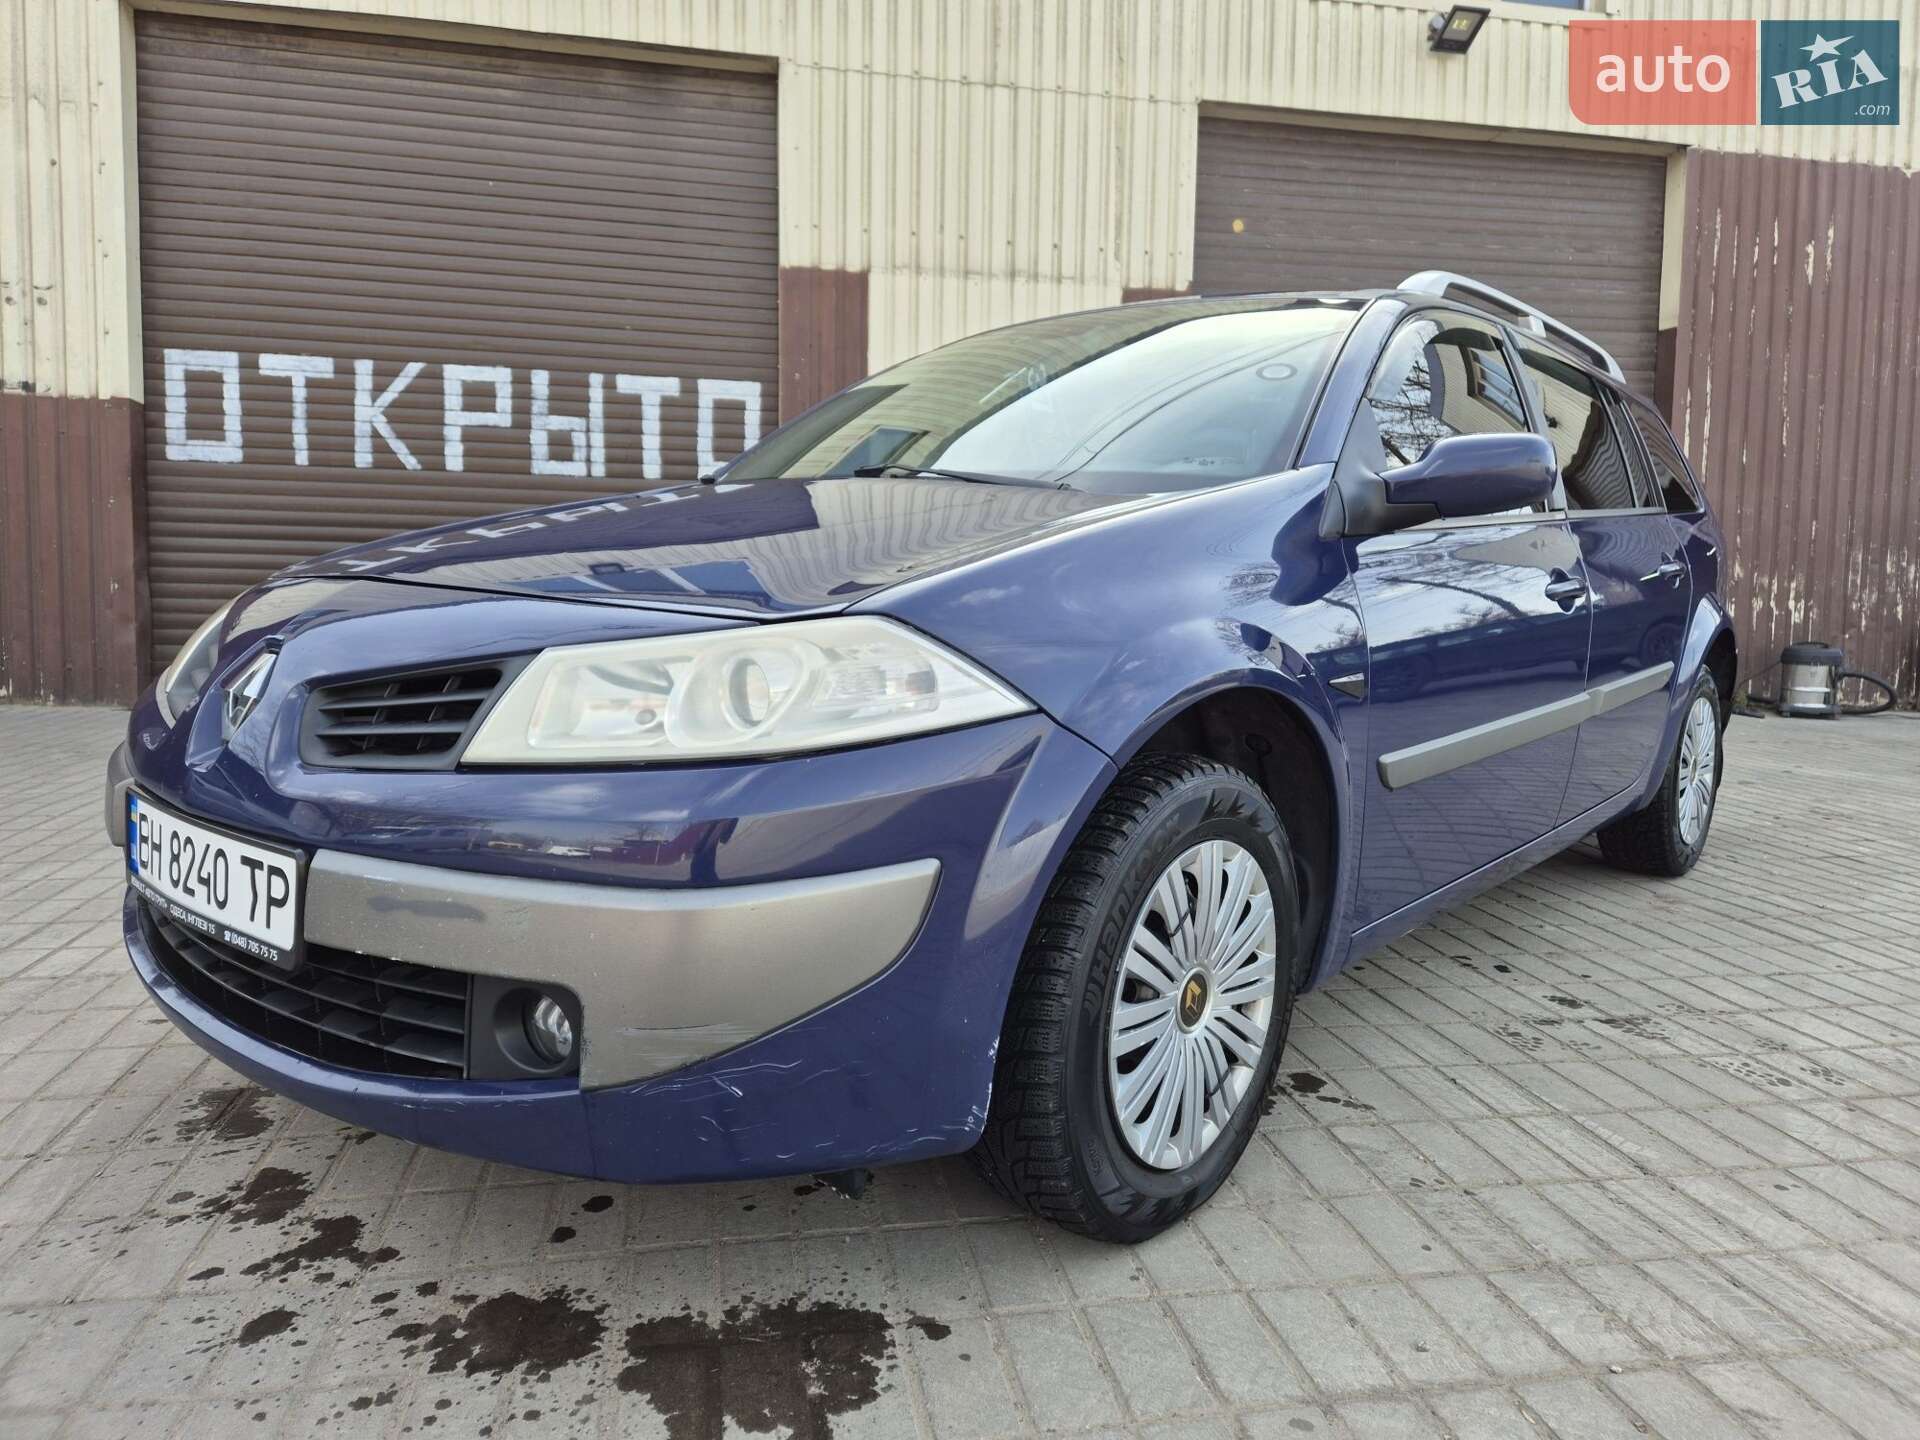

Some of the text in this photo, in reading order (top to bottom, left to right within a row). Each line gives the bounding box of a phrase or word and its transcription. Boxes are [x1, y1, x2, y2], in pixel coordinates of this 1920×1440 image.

[163, 348, 762, 480] ОТКРЫТО
[169, 830, 229, 910] 8240
[240, 855, 290, 929] TP
